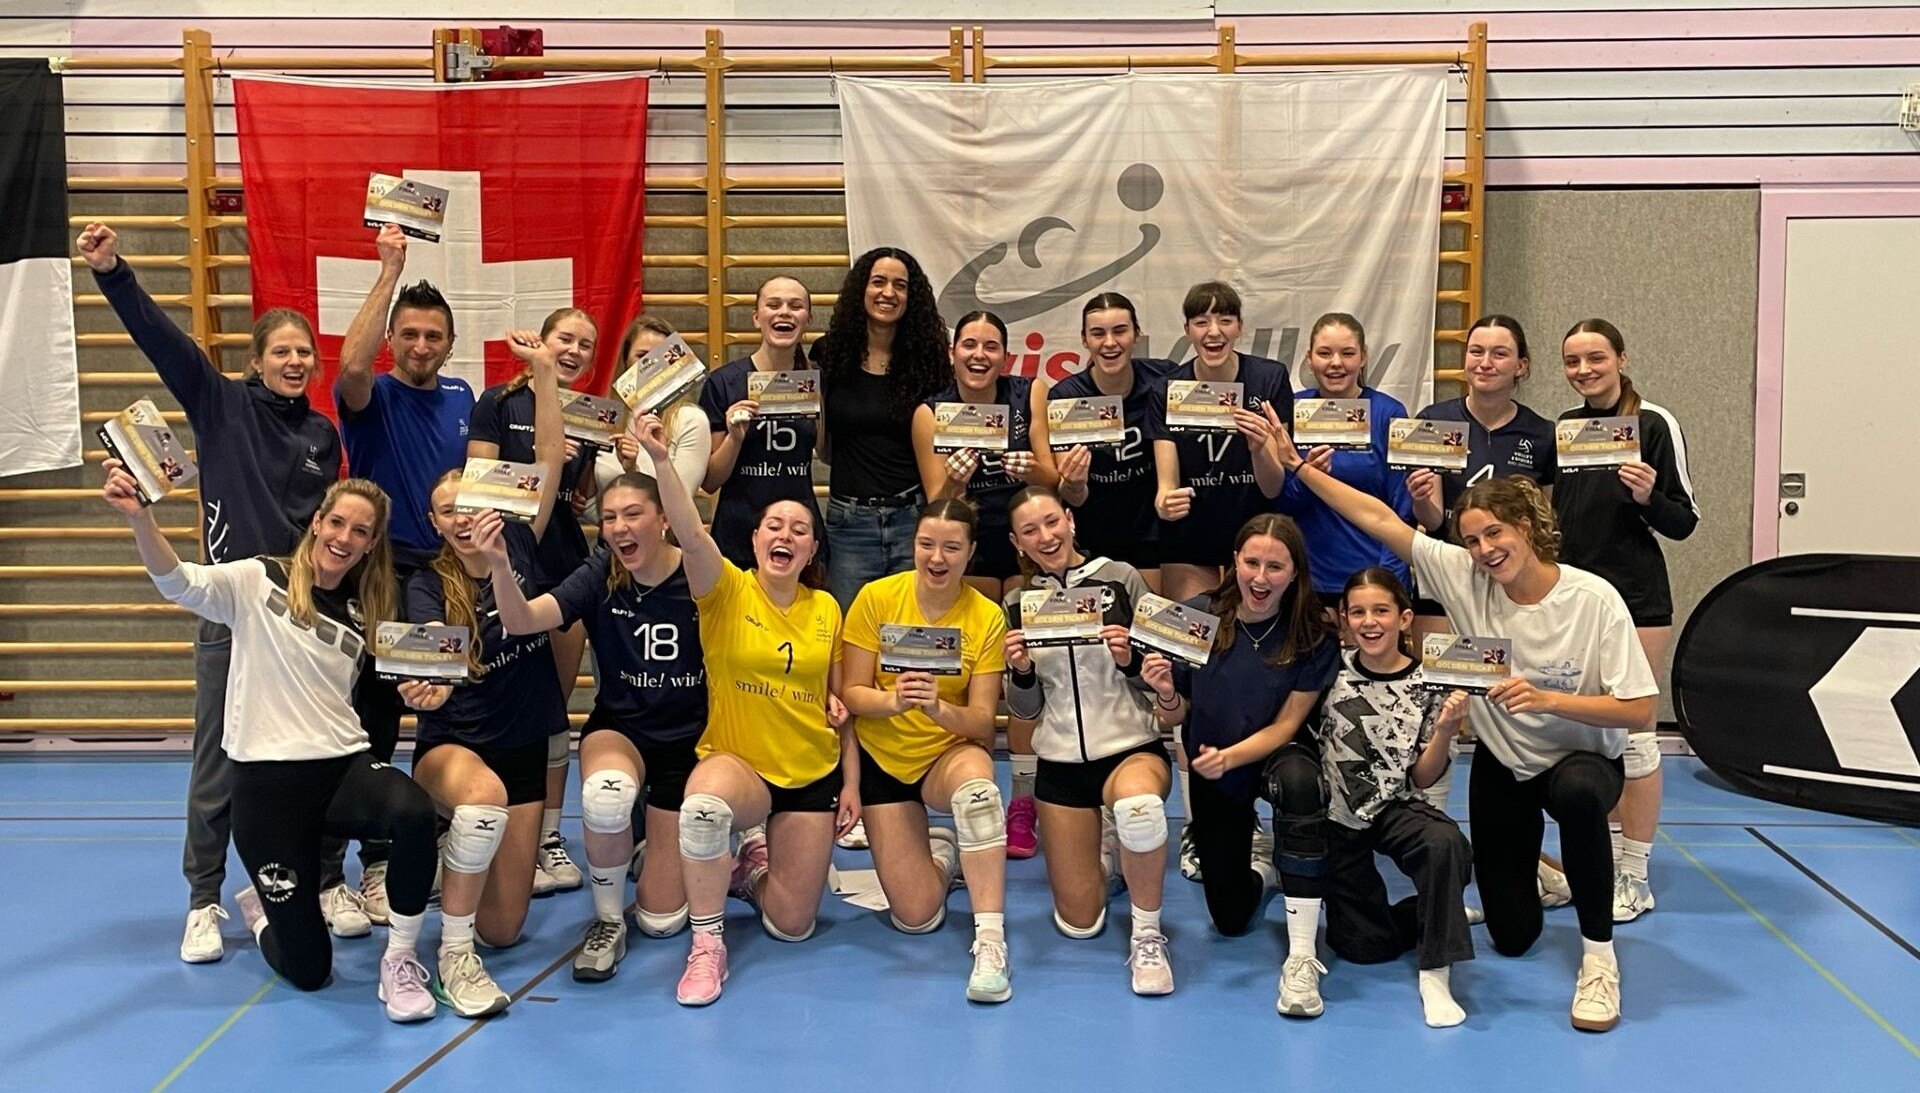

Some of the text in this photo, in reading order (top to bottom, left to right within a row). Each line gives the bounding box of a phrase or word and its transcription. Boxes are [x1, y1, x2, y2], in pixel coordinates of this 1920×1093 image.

[756, 419, 797, 452] 15
[740, 461, 782, 477] smile!
[633, 622, 679, 661] 18
[735, 679, 785, 700] smile!
